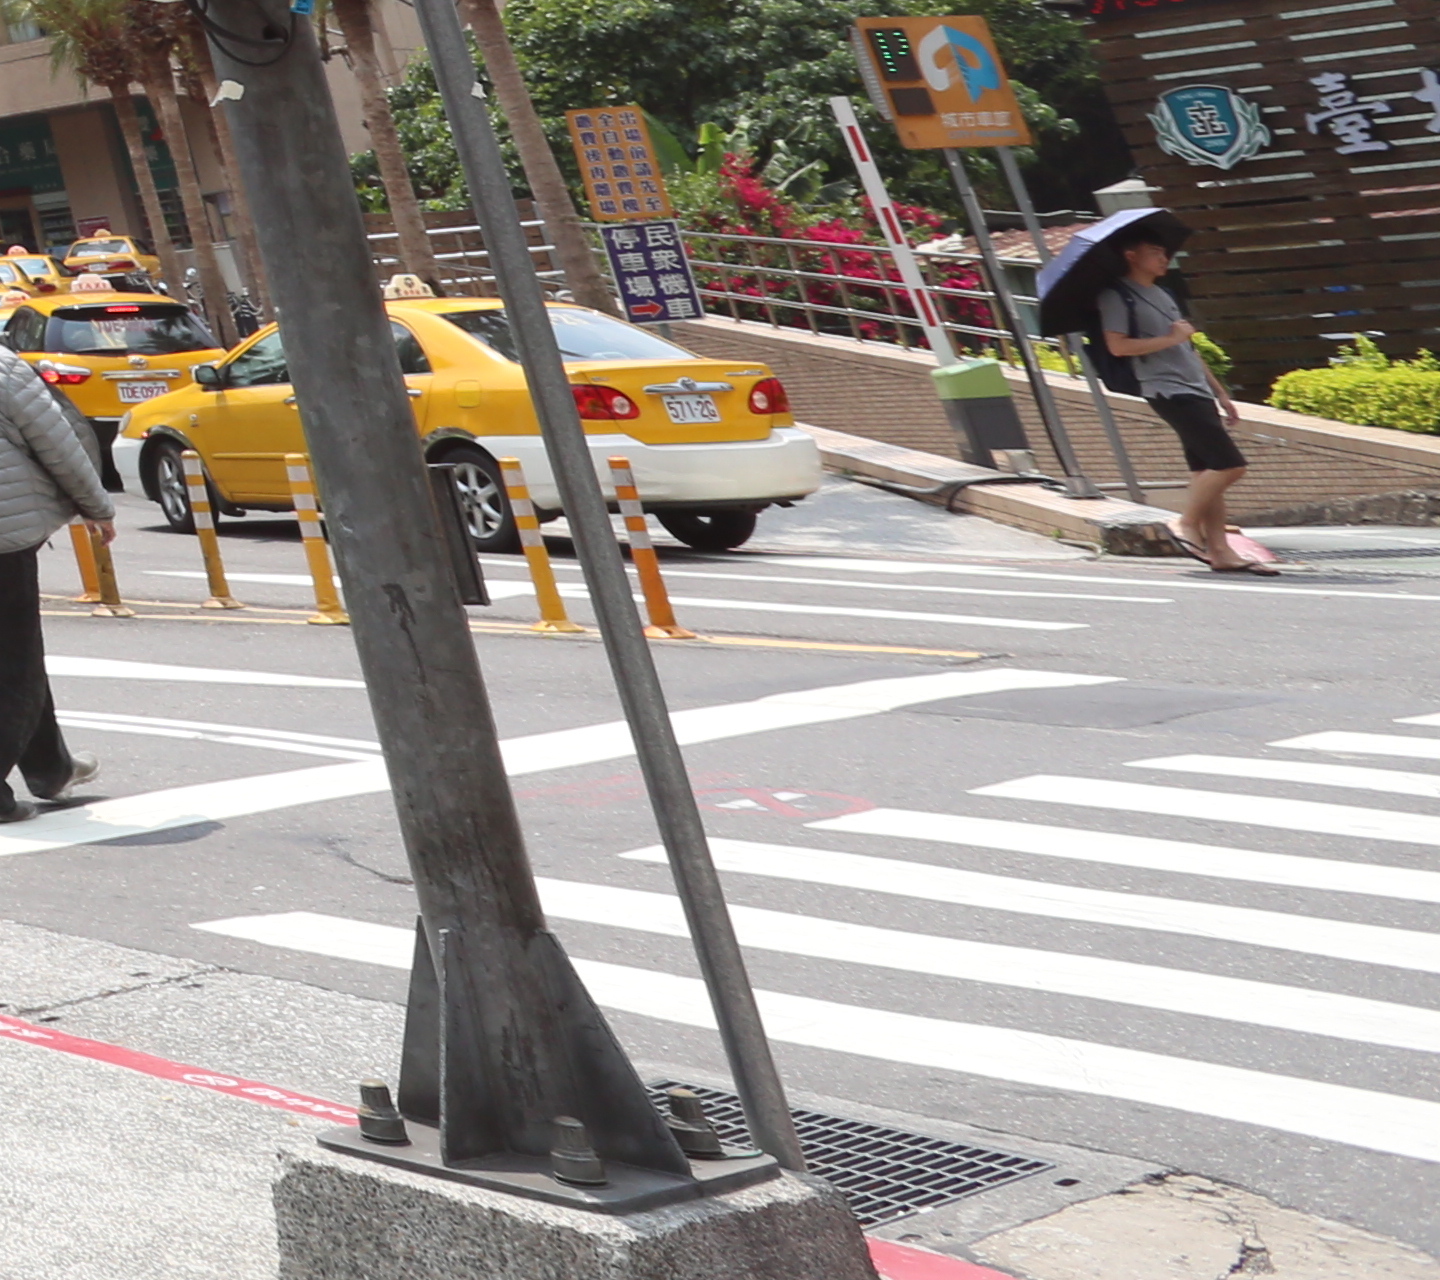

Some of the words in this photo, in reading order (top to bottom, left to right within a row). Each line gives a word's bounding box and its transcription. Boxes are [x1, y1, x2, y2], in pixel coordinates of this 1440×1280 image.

[611, 228, 656, 298] 停車場
[644, 225, 697, 318] 民眾機車
[666, 400, 717, 420] 571-2G
